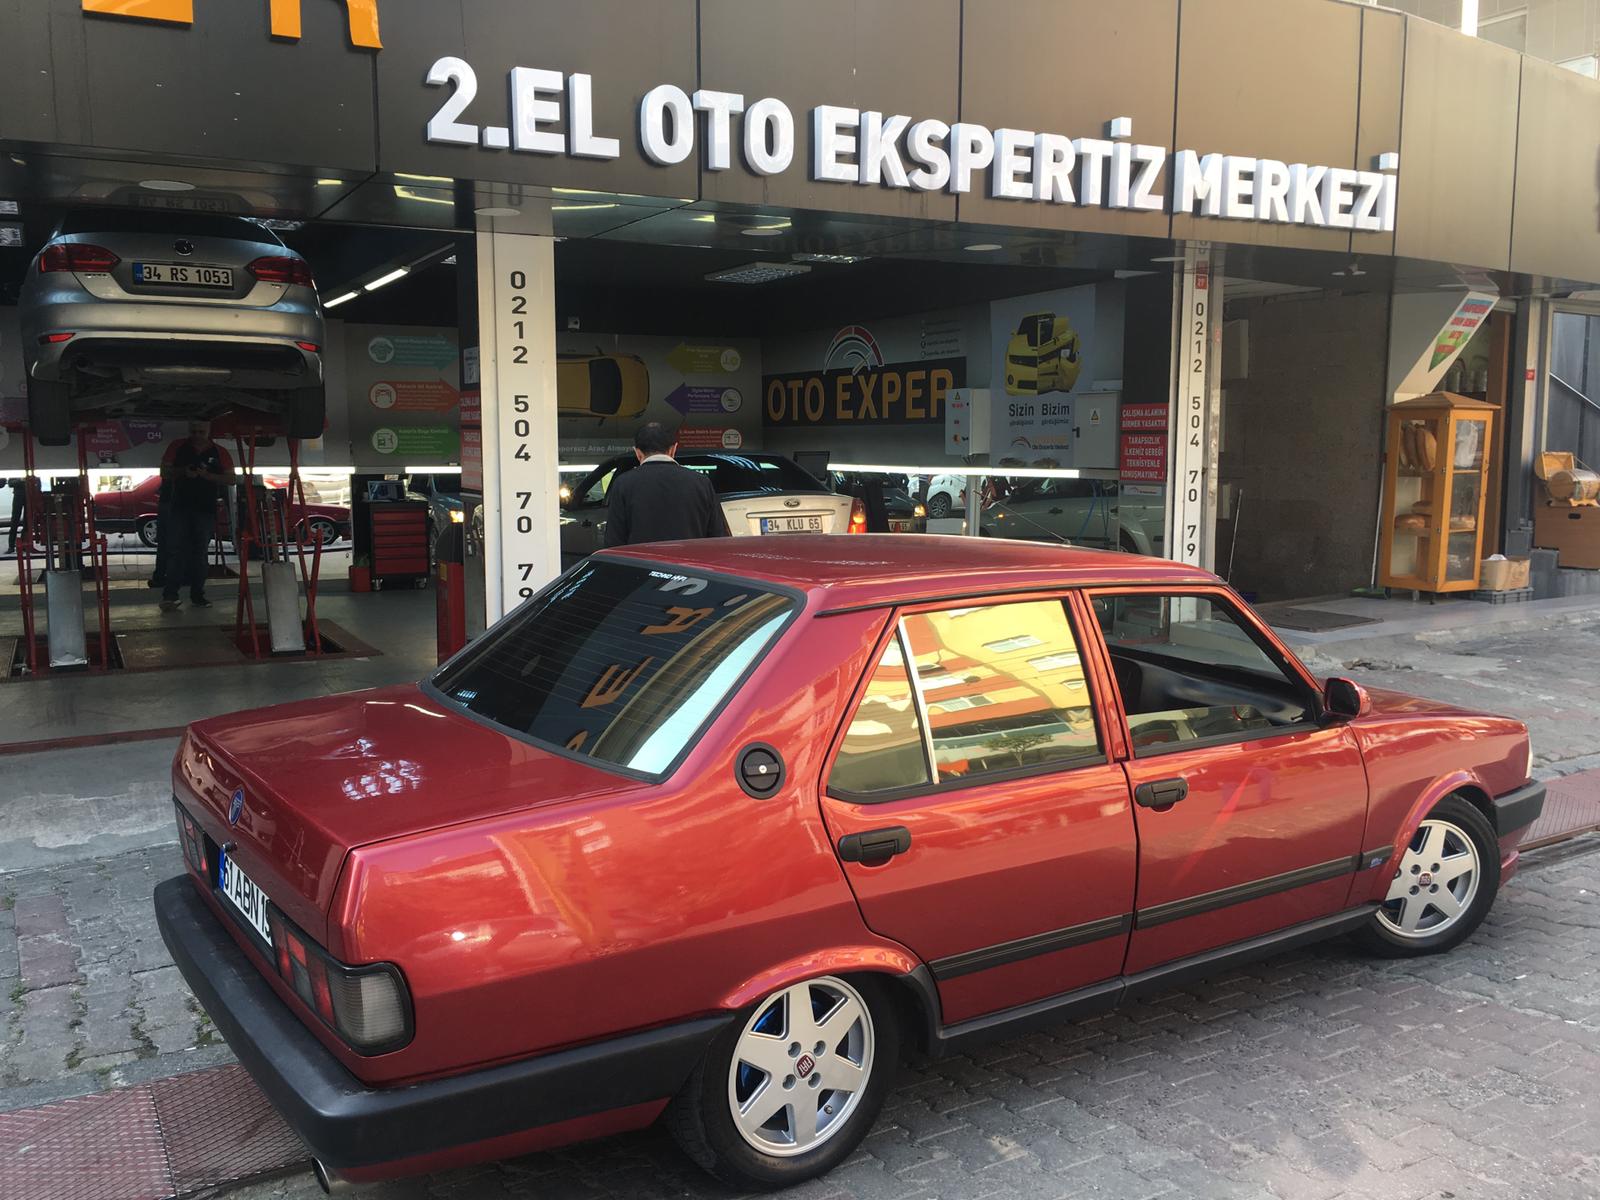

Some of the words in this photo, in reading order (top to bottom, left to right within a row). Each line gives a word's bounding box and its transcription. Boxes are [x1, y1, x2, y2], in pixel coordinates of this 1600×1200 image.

[640, 84, 795, 175] OTO
[814, 104, 1167, 212] EKSPERTİZ
[1173, 149, 1399, 233] MERKEZİ
[144, 266, 161, 280] 34
[170, 267, 188, 282] RS
[196, 269, 230, 284] 1053
[510, 270, 529, 364] 0212
[1193, 301, 1206, 373] 0212
[767, 377, 825, 422] OTO
[836, 368, 953, 420] EXPER
[1008, 403, 1034, 417] Sizin
[1041, 402, 1070, 416] Bizim
[513, 394, 532, 462] 504
[1190, 396, 1201, 447] 504
[1188, 470, 1199, 503] 70
[515, 491, 532, 534] 70
[768, 519, 780, 531] 34
[786, 518, 804, 530] KLU
[808, 518, 820, 530] 65
[1186, 524, 1198, 557] 79
[223, 855, 233, 896] 61
[235, 869, 259, 925] ABN
[798, 1056, 813, 1076] FIAT
